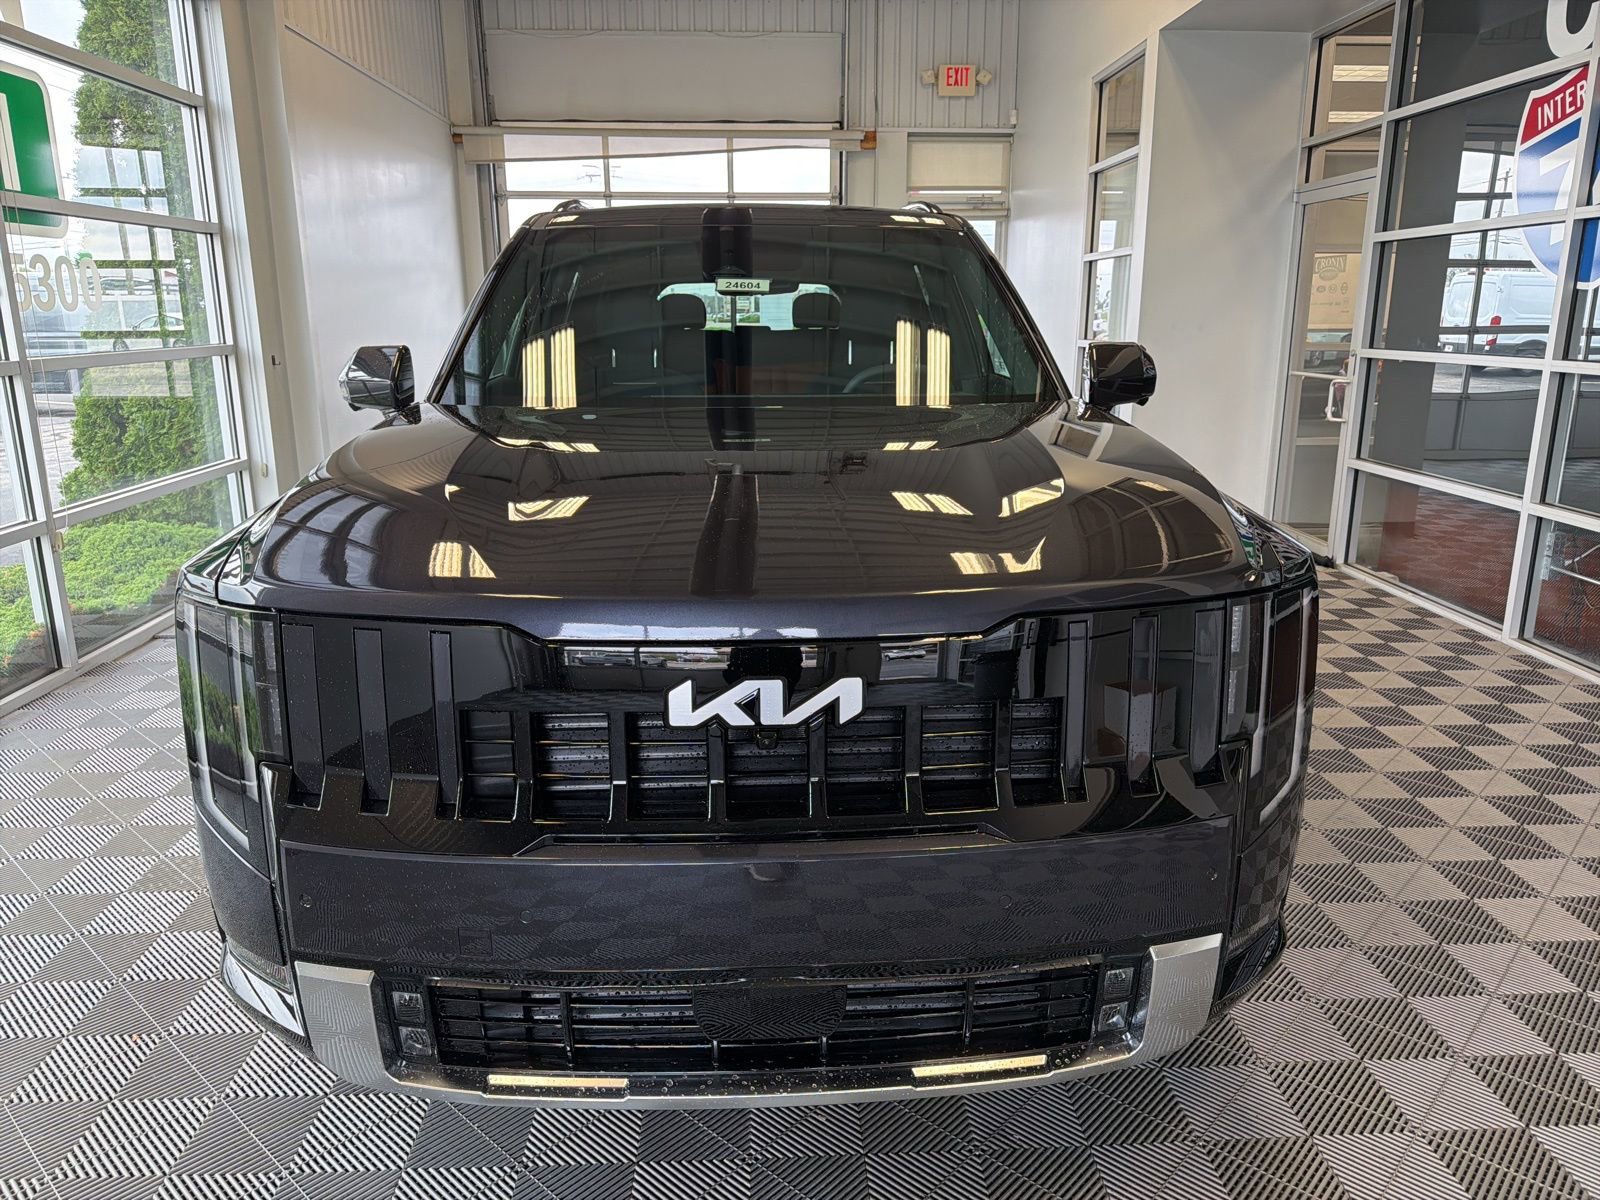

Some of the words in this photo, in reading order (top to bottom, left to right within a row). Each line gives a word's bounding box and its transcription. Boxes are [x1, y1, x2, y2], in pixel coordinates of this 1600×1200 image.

[946, 67, 970, 87] EXIT
[725, 281, 761, 289] 24604
[668, 677, 862, 726] KIA
